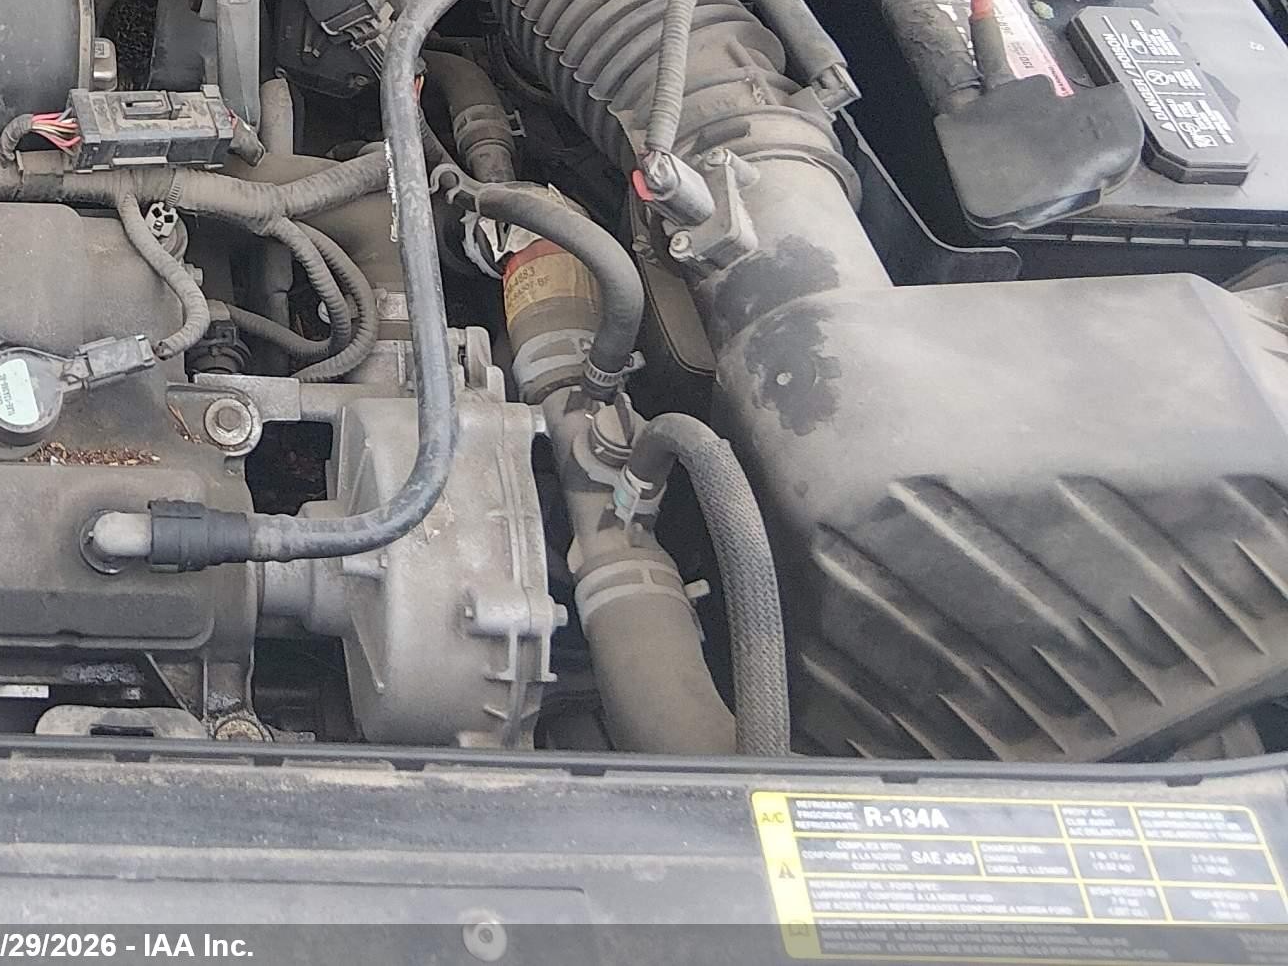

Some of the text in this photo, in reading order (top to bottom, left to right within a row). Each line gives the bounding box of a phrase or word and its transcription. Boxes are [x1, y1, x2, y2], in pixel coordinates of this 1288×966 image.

[1102, 33, 1136, 70] POISON
[1132, 78, 1169, 121] DANGER
[762, 812, 785, 824] A/C
[863, 807, 949, 829] R-134A
[911, 851, 940, 865] SAE
